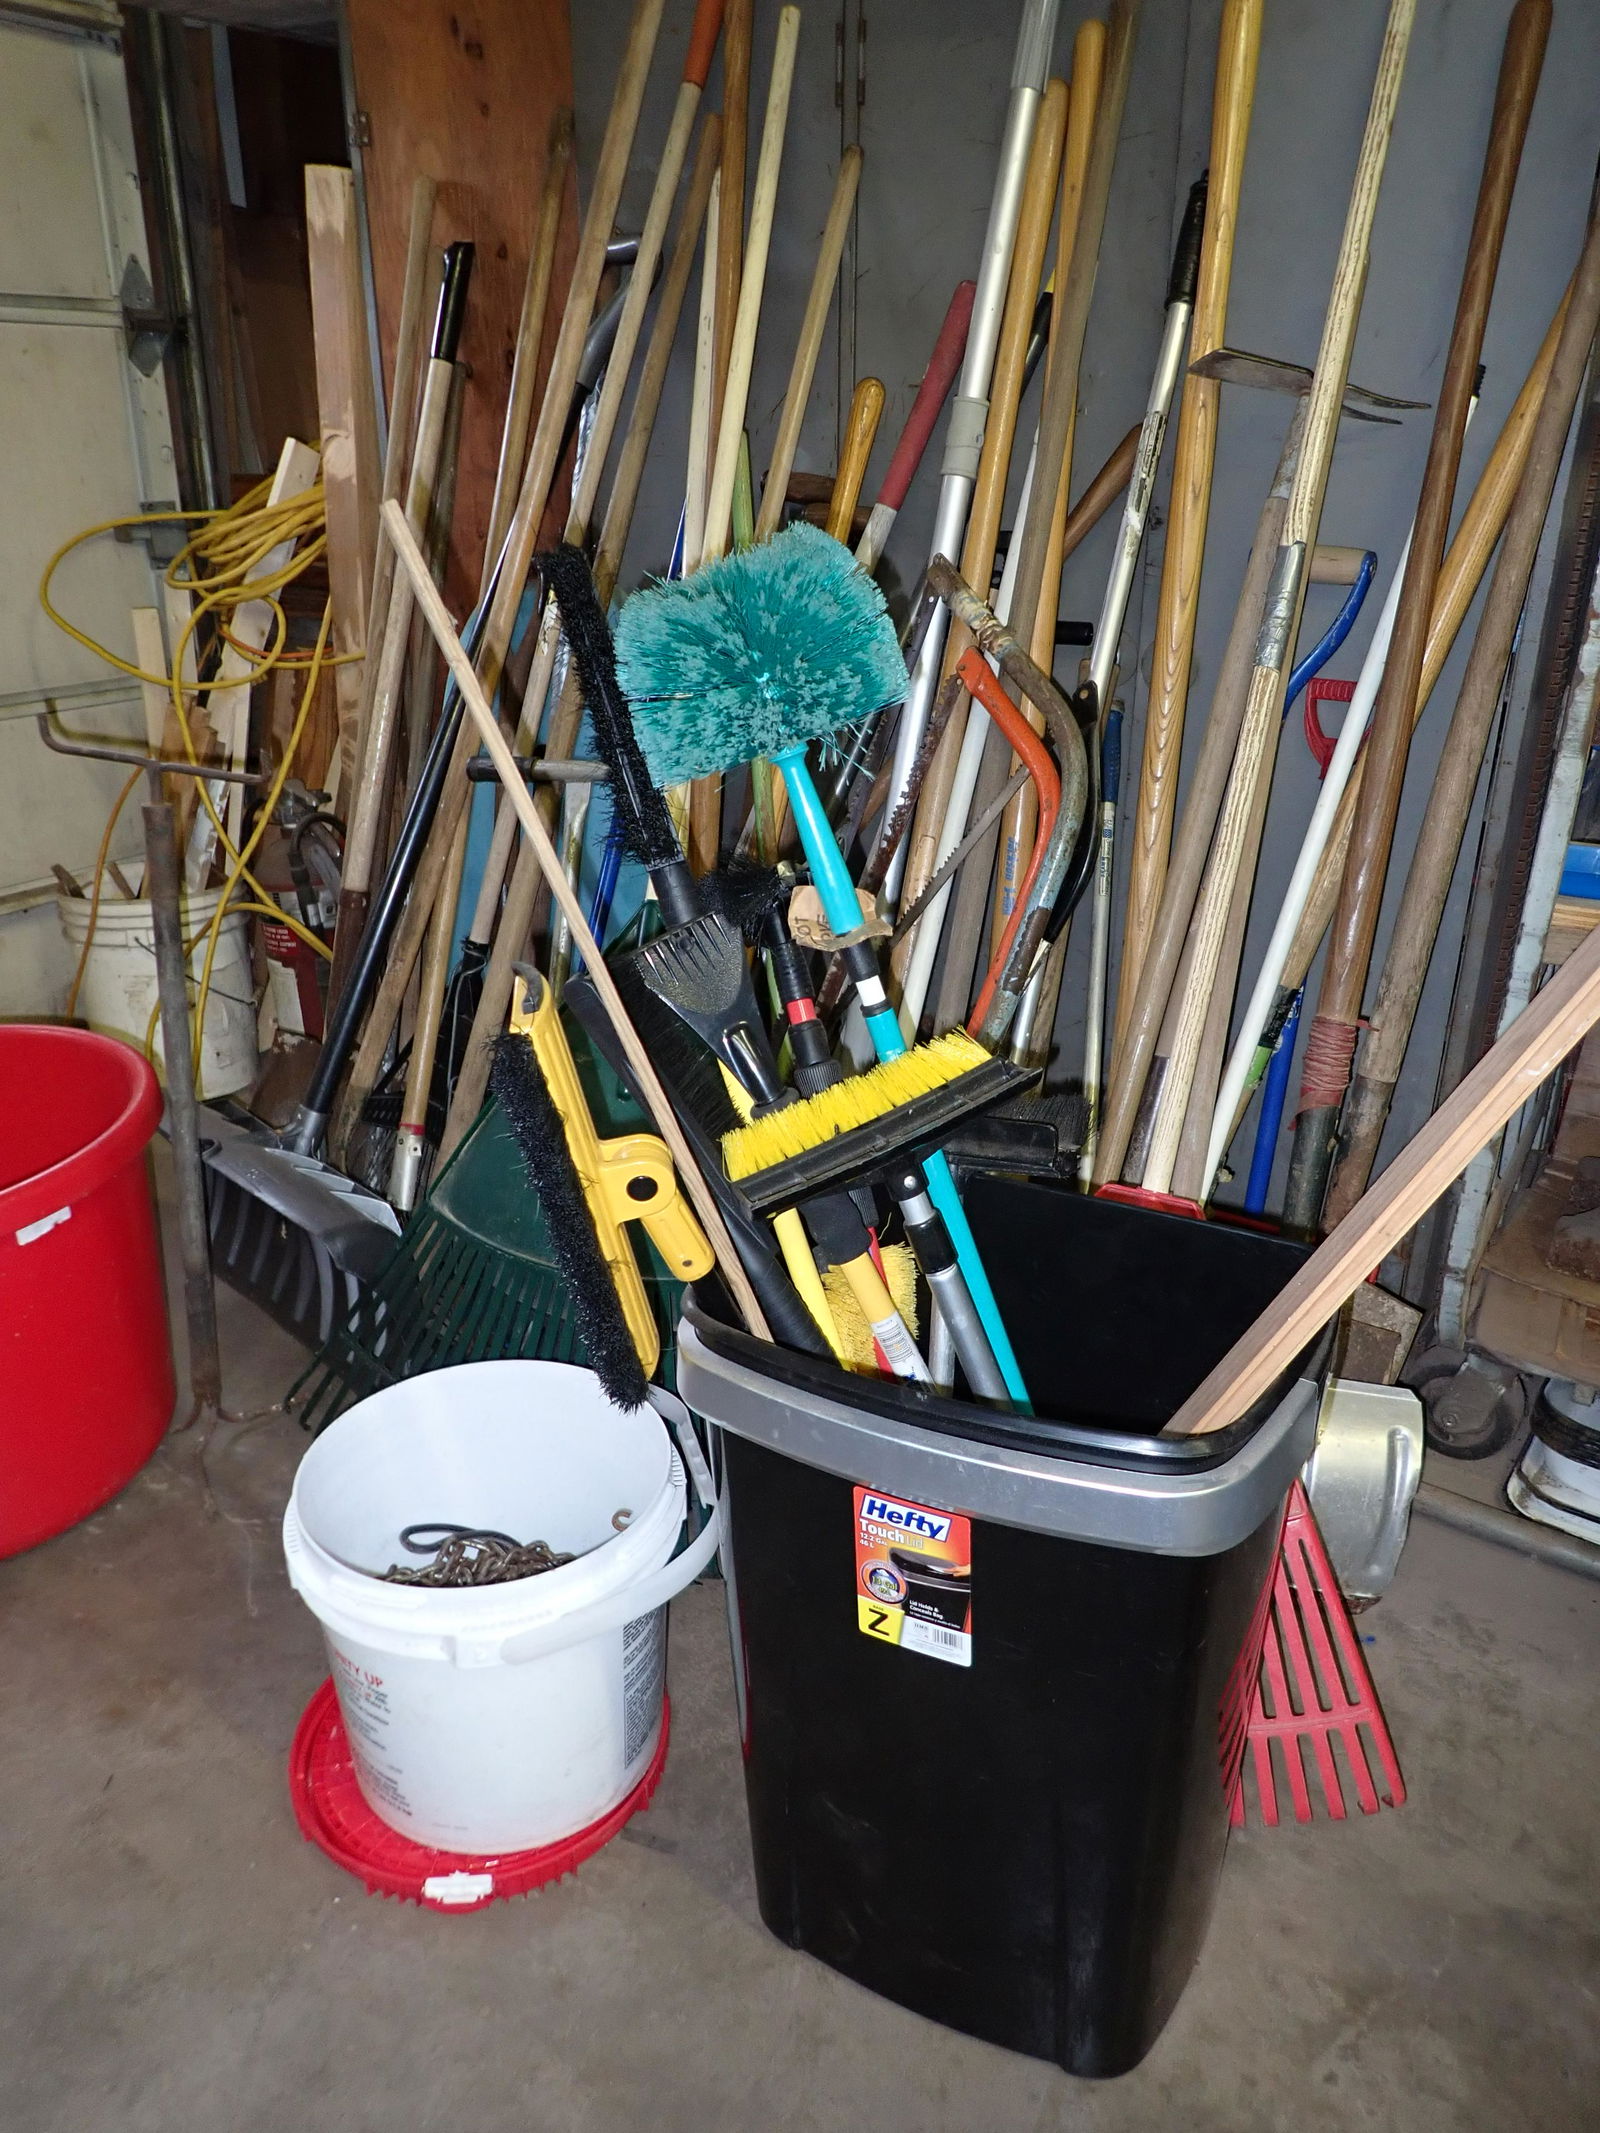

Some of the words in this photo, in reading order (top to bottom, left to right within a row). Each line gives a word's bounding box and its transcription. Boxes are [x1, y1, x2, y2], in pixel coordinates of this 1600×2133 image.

[860, 1519, 904, 1544] Touch
[906, 1535, 923, 1550] Lid
[866, 1499, 945, 1539] Hefty
[868, 1607, 890, 1637] Z
